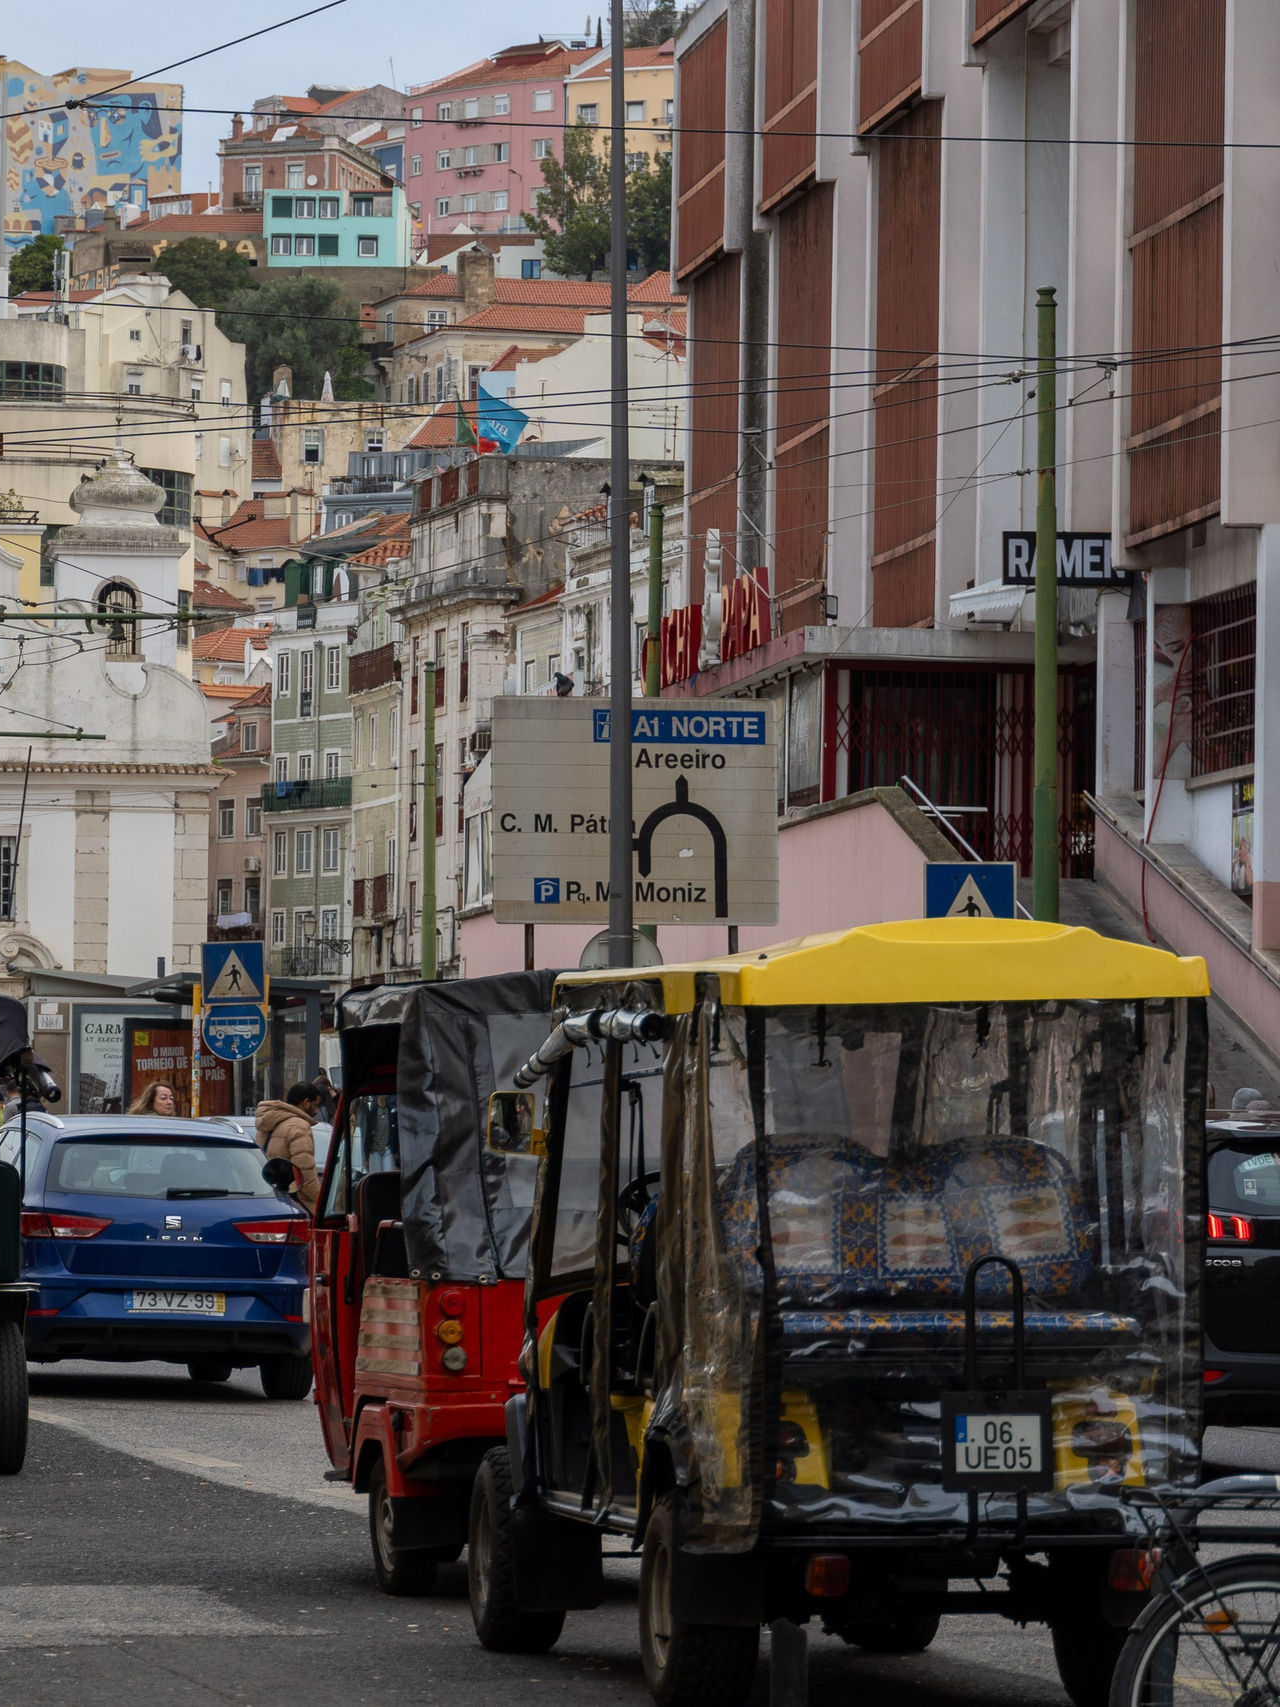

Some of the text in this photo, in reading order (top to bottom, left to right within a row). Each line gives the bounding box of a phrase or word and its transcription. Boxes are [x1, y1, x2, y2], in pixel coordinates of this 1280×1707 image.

[1008, 538, 1126, 579] RMEN
[633, 716, 759, 738] A1 NORTE
[635, 748, 726, 769] Areeiro
[500, 813, 521, 832] C.
[534, 814, 557, 833] M.
[636, 881, 706, 902] Moniz
[160, 1047, 185, 1056] MAIOR
[136, 1059, 174, 1071] TORNEIO
[176, 1057, 188, 1069] DE
[205, 1067, 226, 1081] PAÍS
[965, 1446, 1032, 1469] UE05
